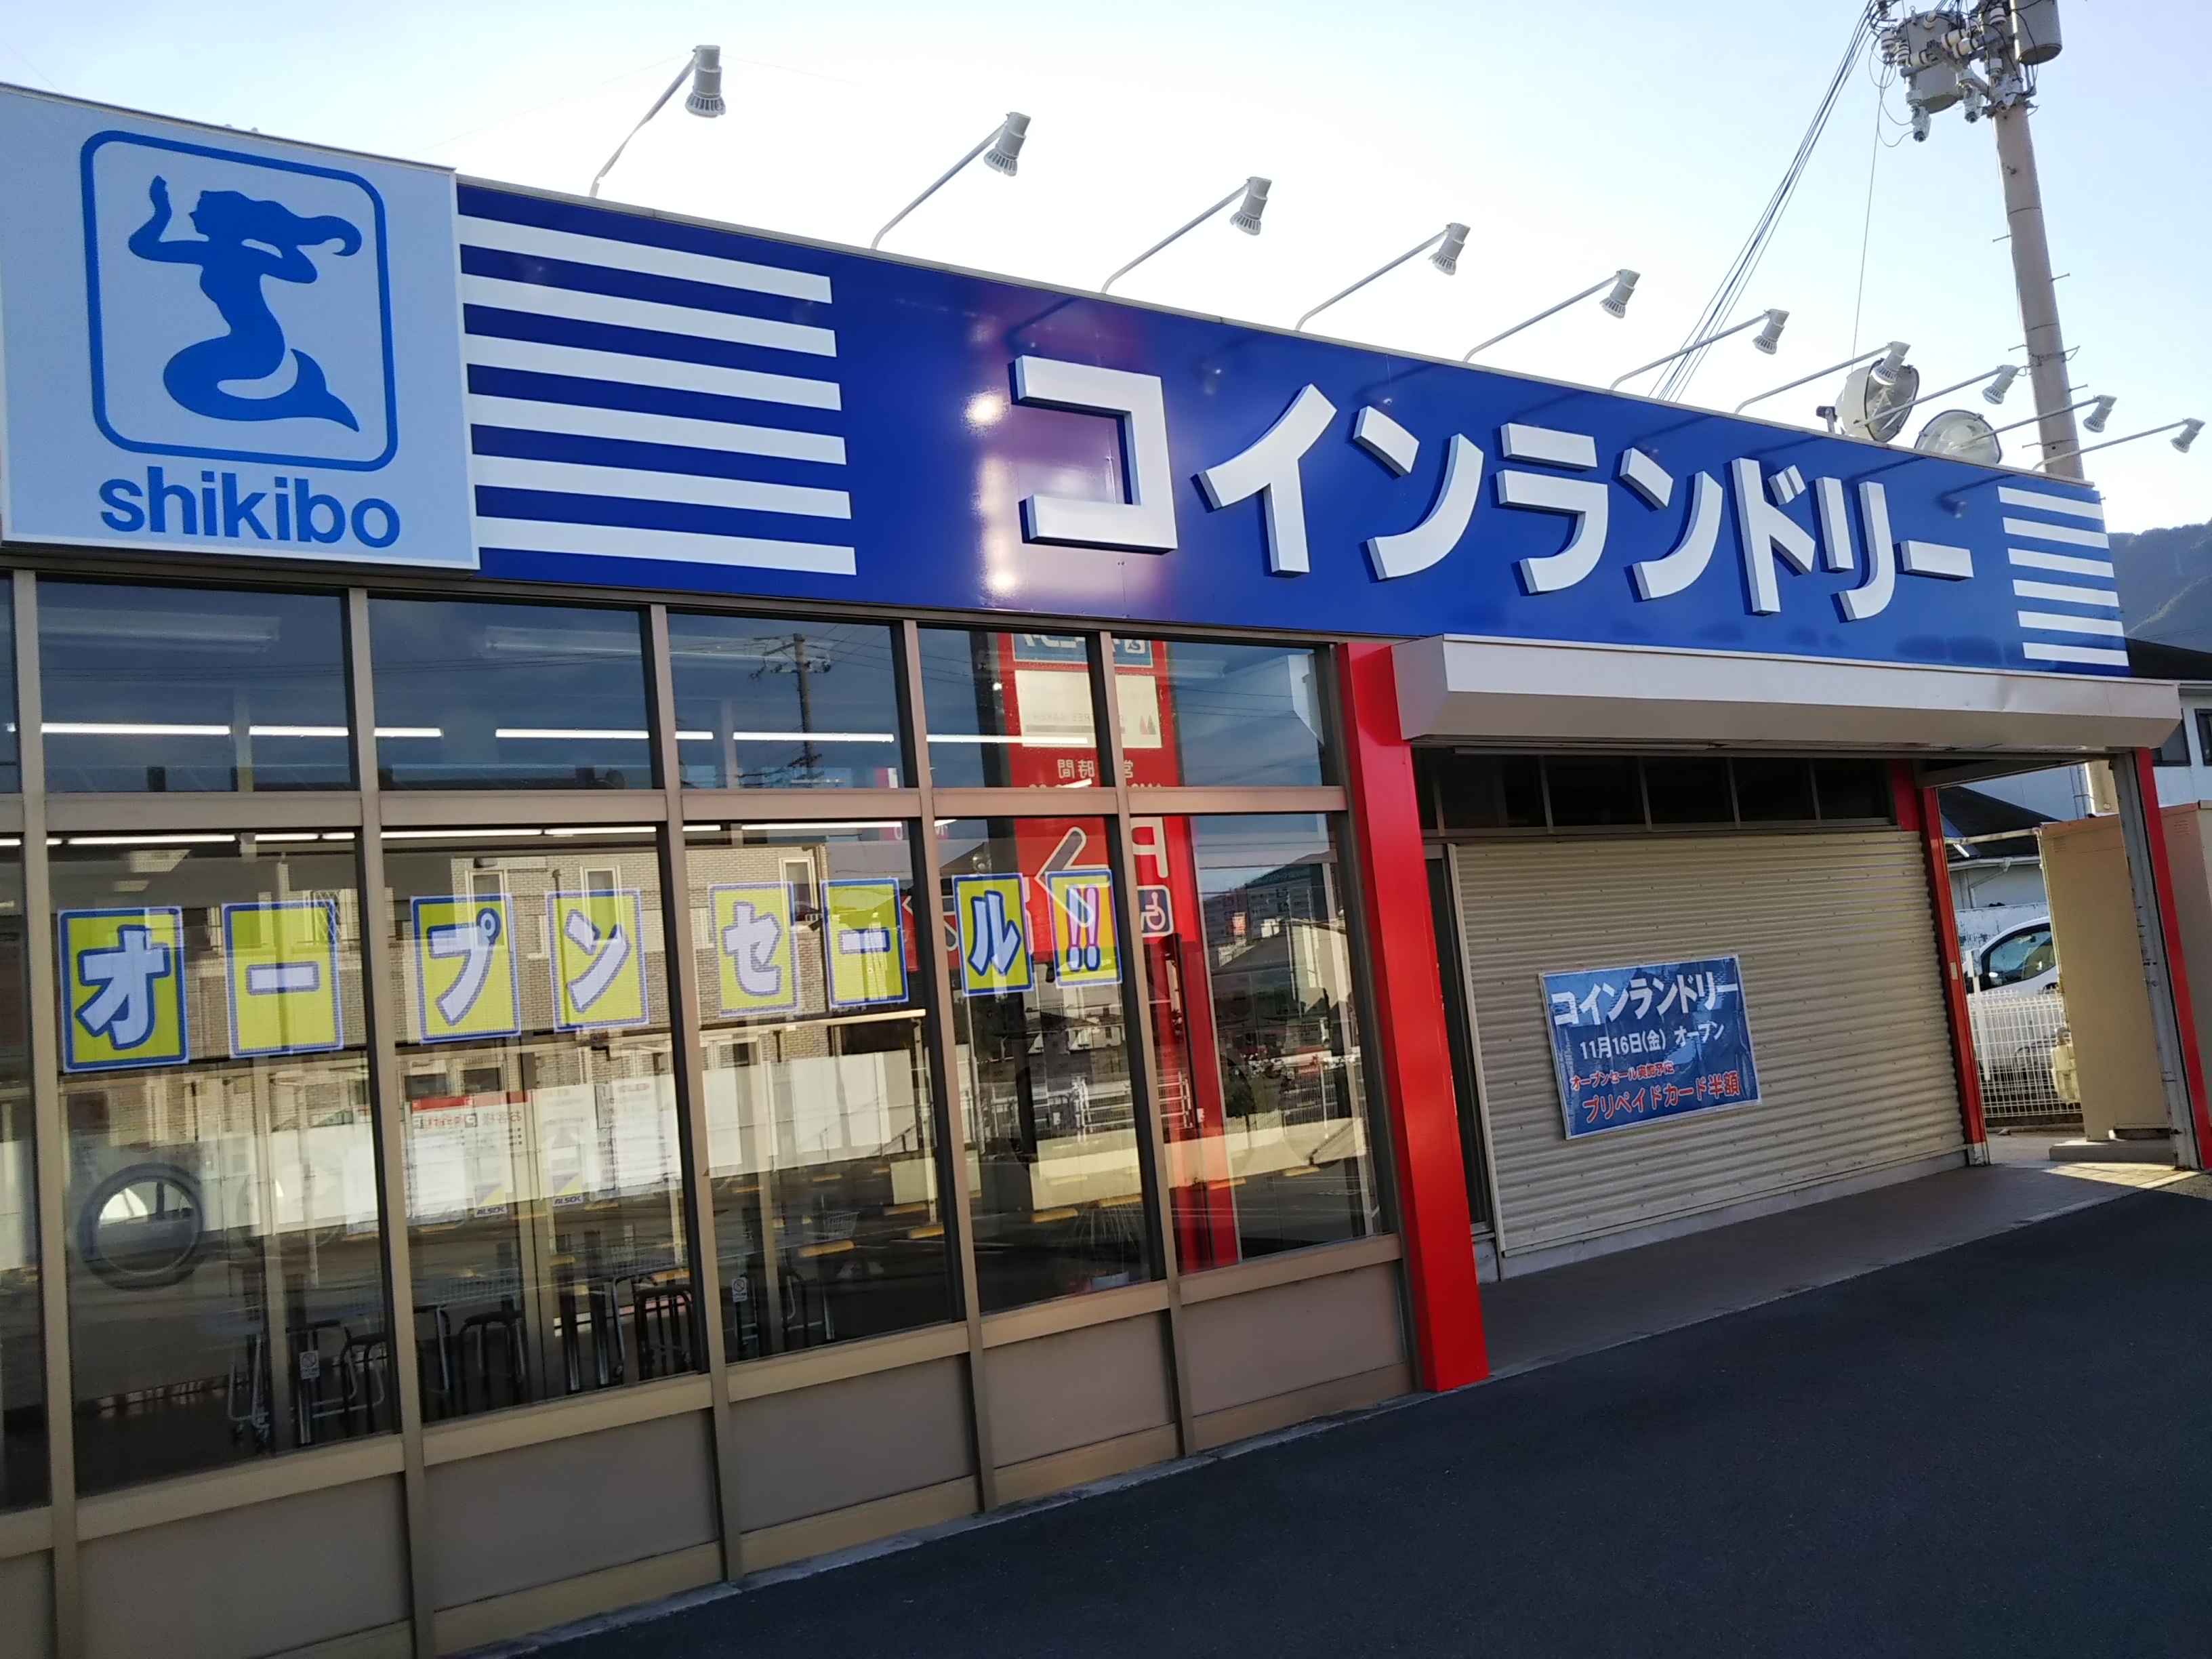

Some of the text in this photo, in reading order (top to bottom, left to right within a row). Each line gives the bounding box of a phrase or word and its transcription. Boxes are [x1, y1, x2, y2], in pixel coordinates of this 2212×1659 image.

[99, 466, 401, 548] shikibo
[1014, 354, 1974, 621] コインランドリー
[1551, 970, 1739, 1026] コインランドリー
[1579, 1021, 1725, 1060] 11月16日(金) オープン
[1570, 1061, 1675, 1092] オープンセール実施予定
[1582, 1069, 1741, 1124] プリペイドカード半額
